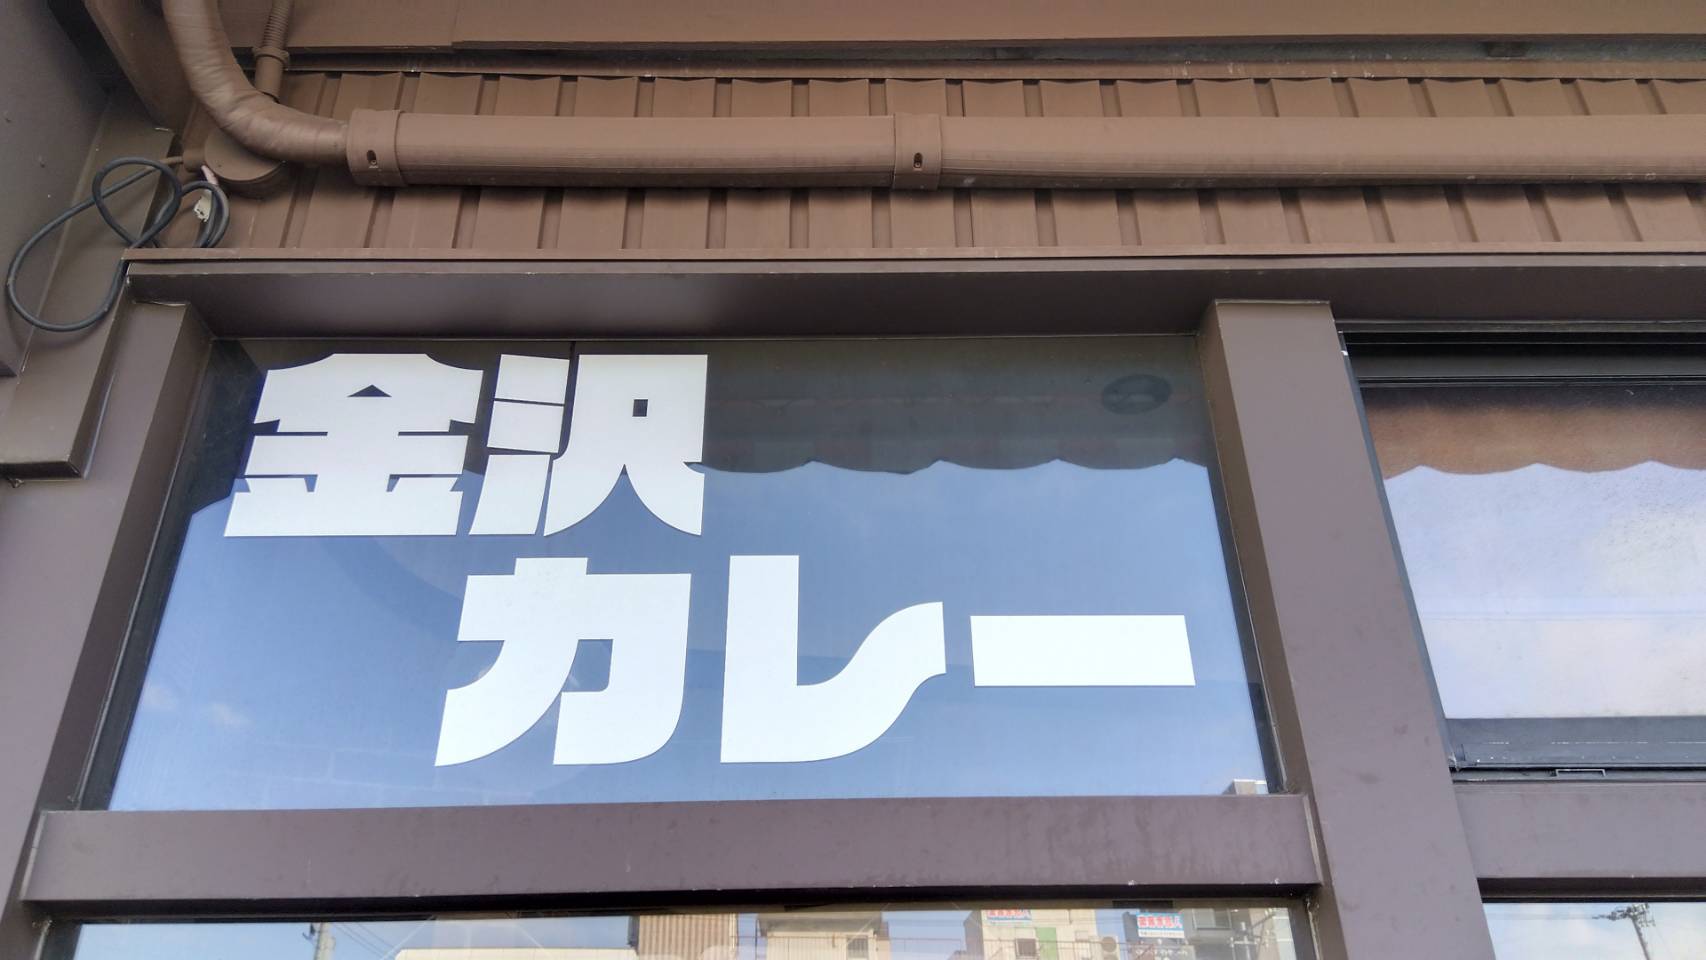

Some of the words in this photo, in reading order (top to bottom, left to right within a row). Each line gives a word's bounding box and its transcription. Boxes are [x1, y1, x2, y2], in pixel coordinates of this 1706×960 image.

[224, 353, 709, 537] 金沢
[434, 555, 1196, 767] カレー
